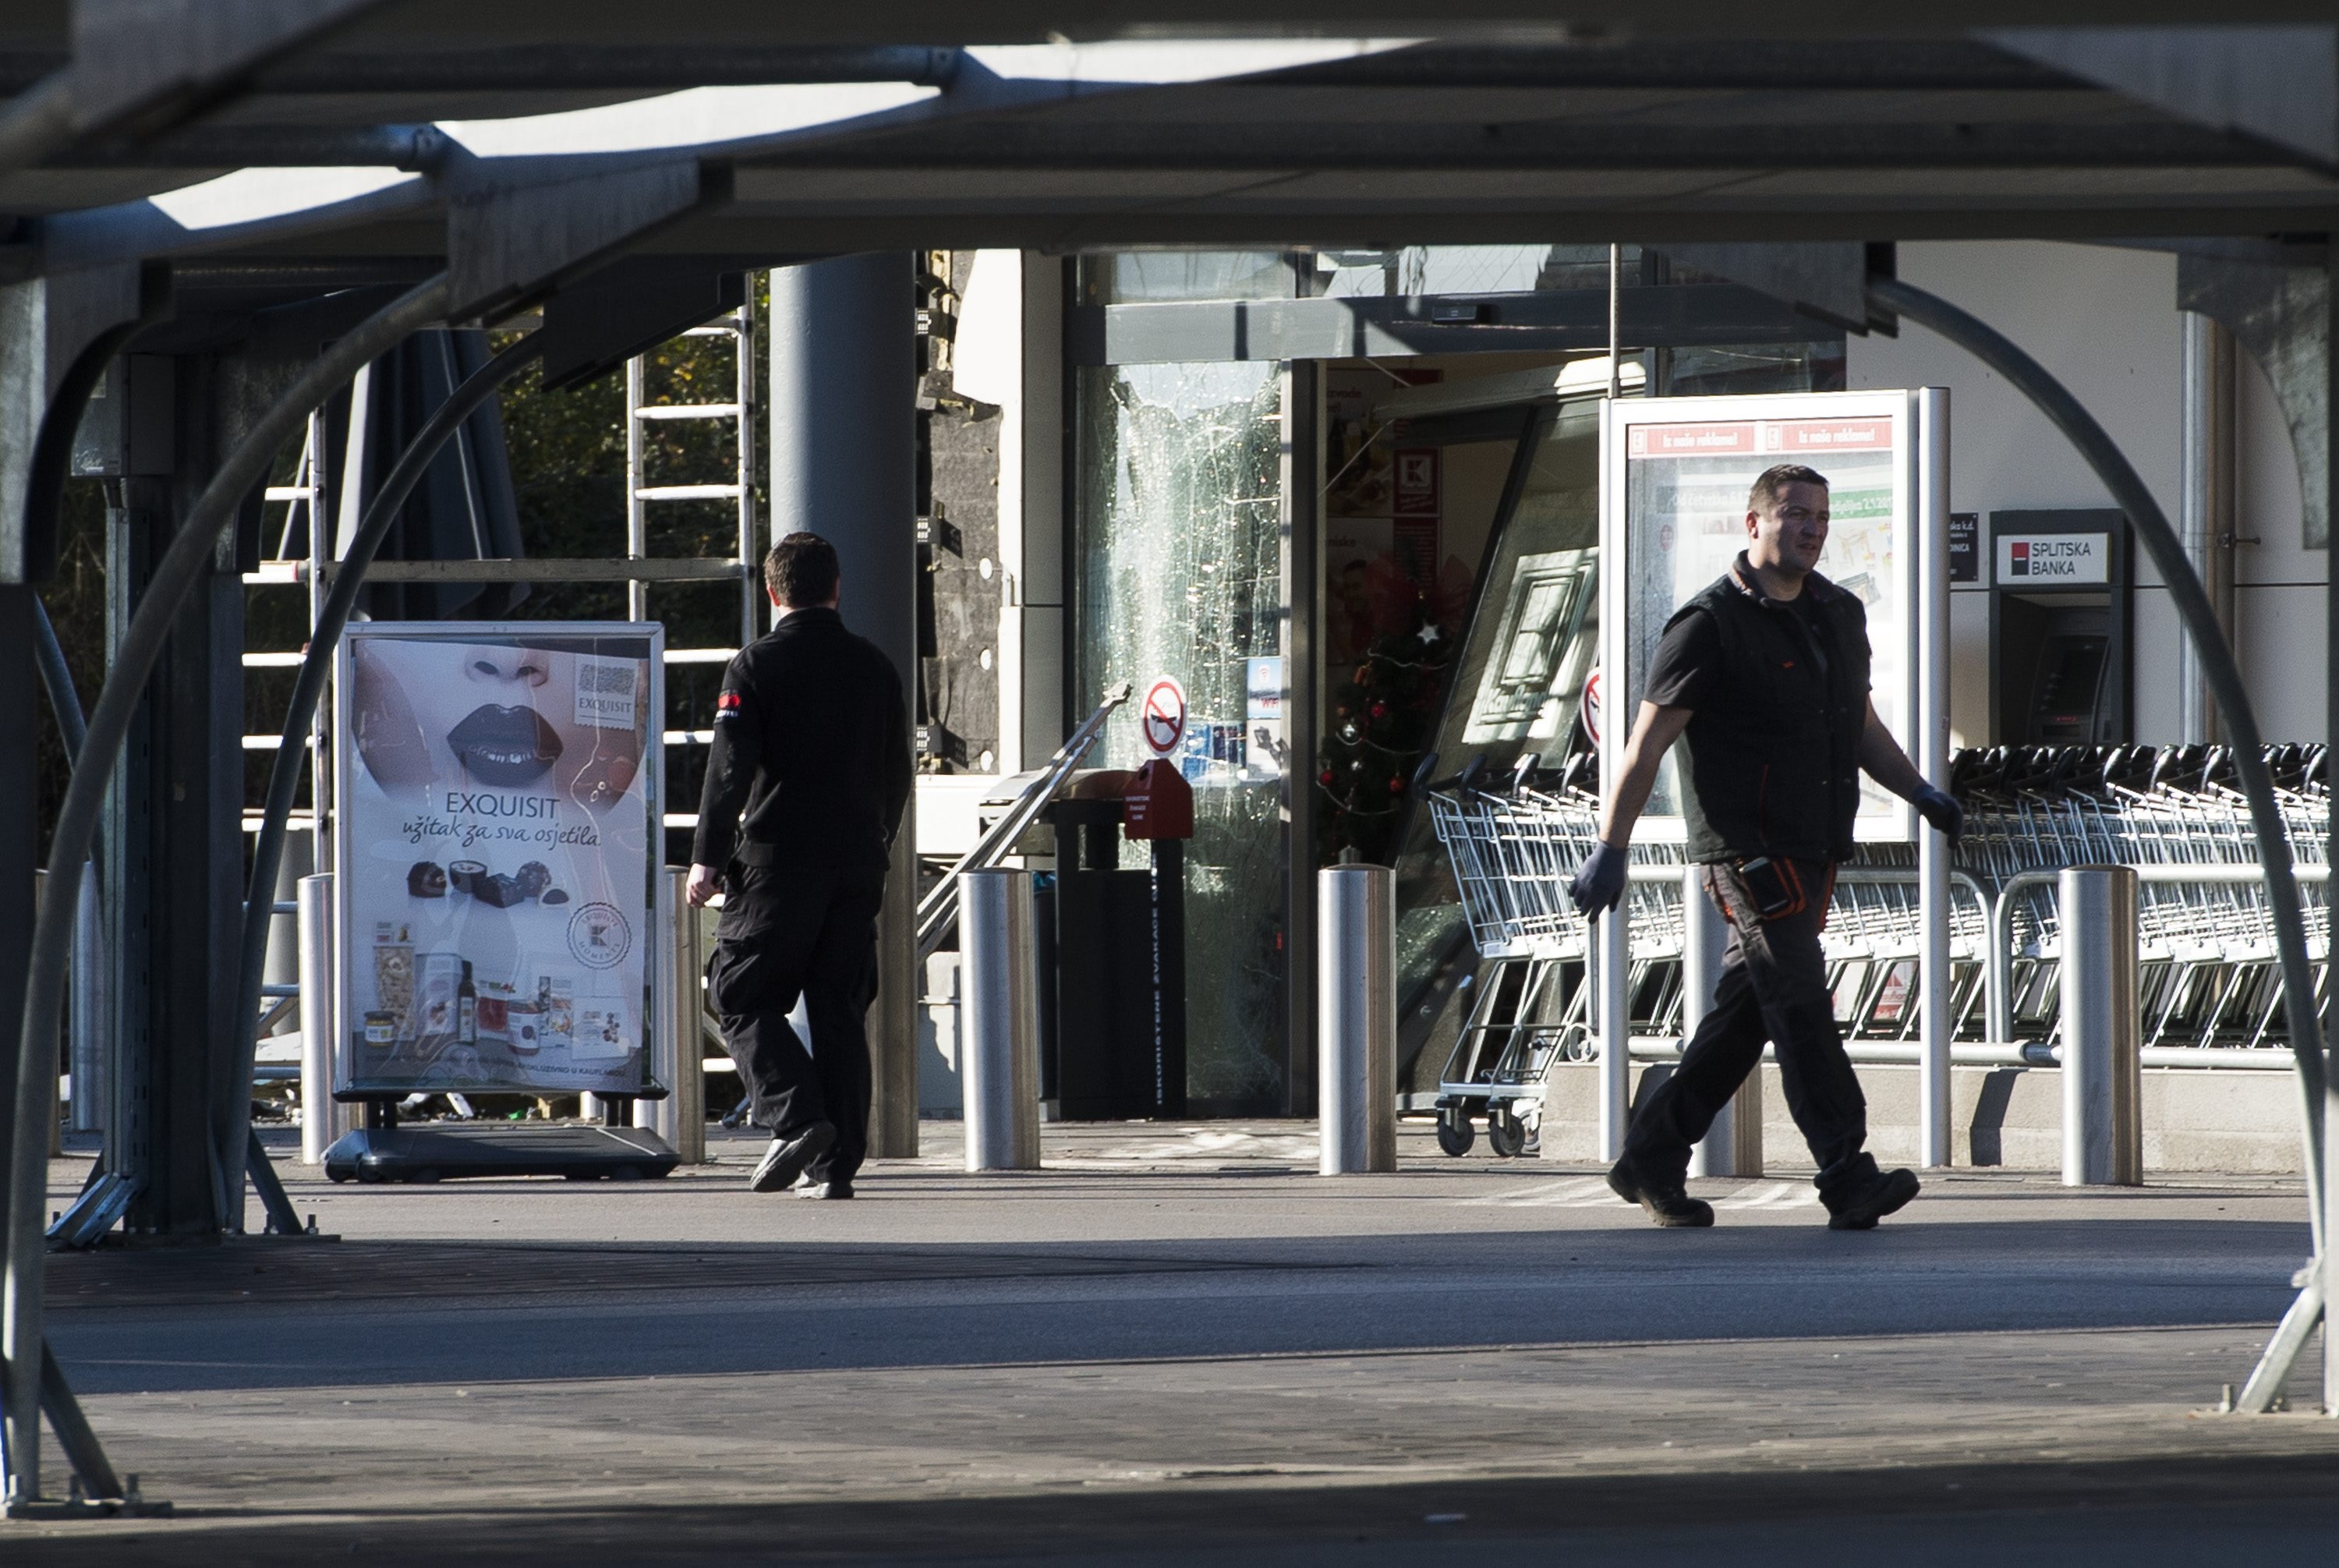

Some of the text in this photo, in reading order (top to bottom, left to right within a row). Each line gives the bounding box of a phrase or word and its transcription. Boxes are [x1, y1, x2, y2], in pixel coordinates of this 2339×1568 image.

[2032, 542, 2091, 557] SPLITSKA
[2032, 561, 2075, 575] BANKA
[579, 697, 632, 713] EXQUISIT
[446, 792, 561, 819] EXQUISIT
[403, 816, 463, 844] užitak
[462, 823, 492, 848] za
[495, 826, 530, 841] sva
